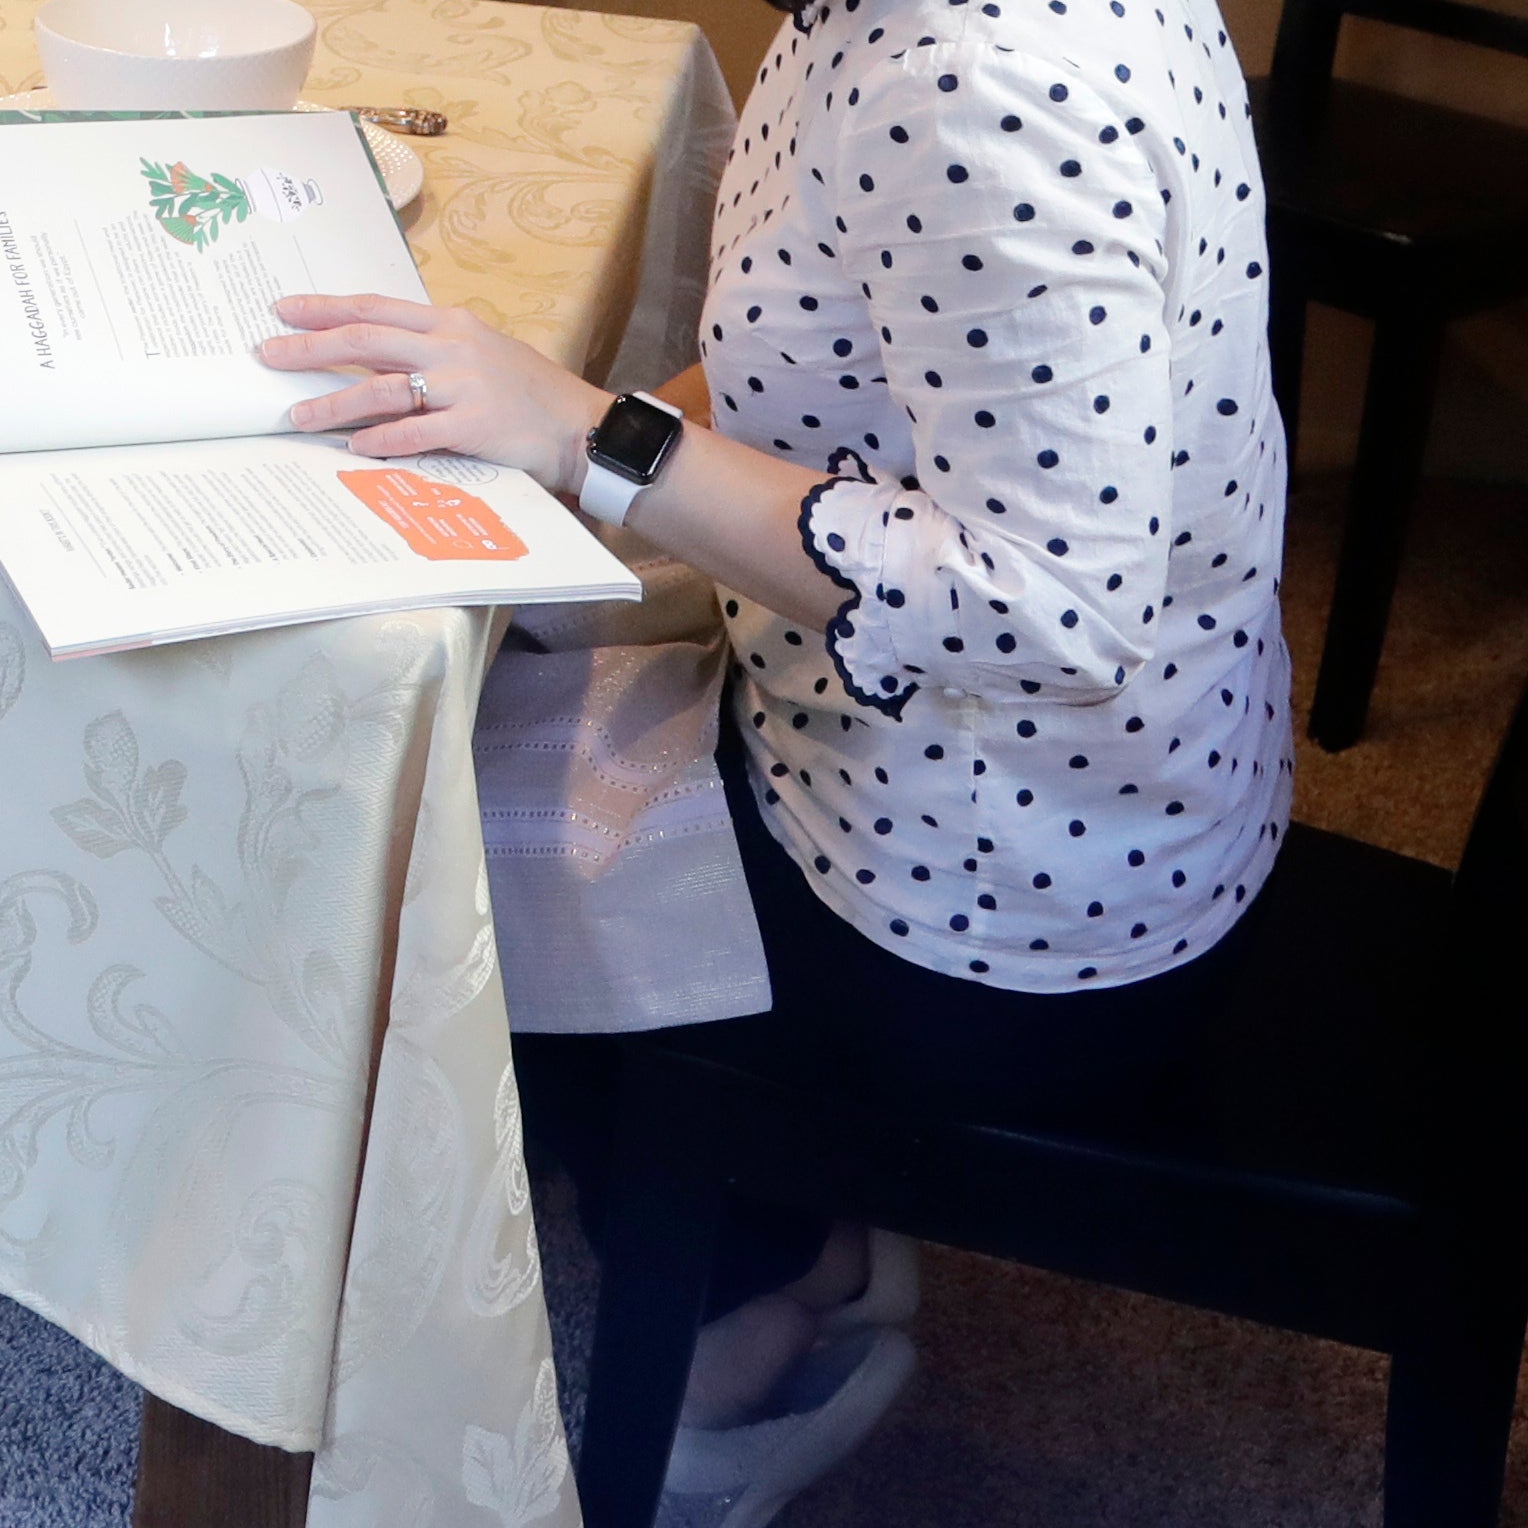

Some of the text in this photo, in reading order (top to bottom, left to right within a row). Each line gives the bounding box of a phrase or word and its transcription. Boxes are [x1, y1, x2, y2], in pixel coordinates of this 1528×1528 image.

[10, 265, 30, 285] FOR
[18, 290, 52, 356] HAGGADAH
[40, 360, 55, 368] A
